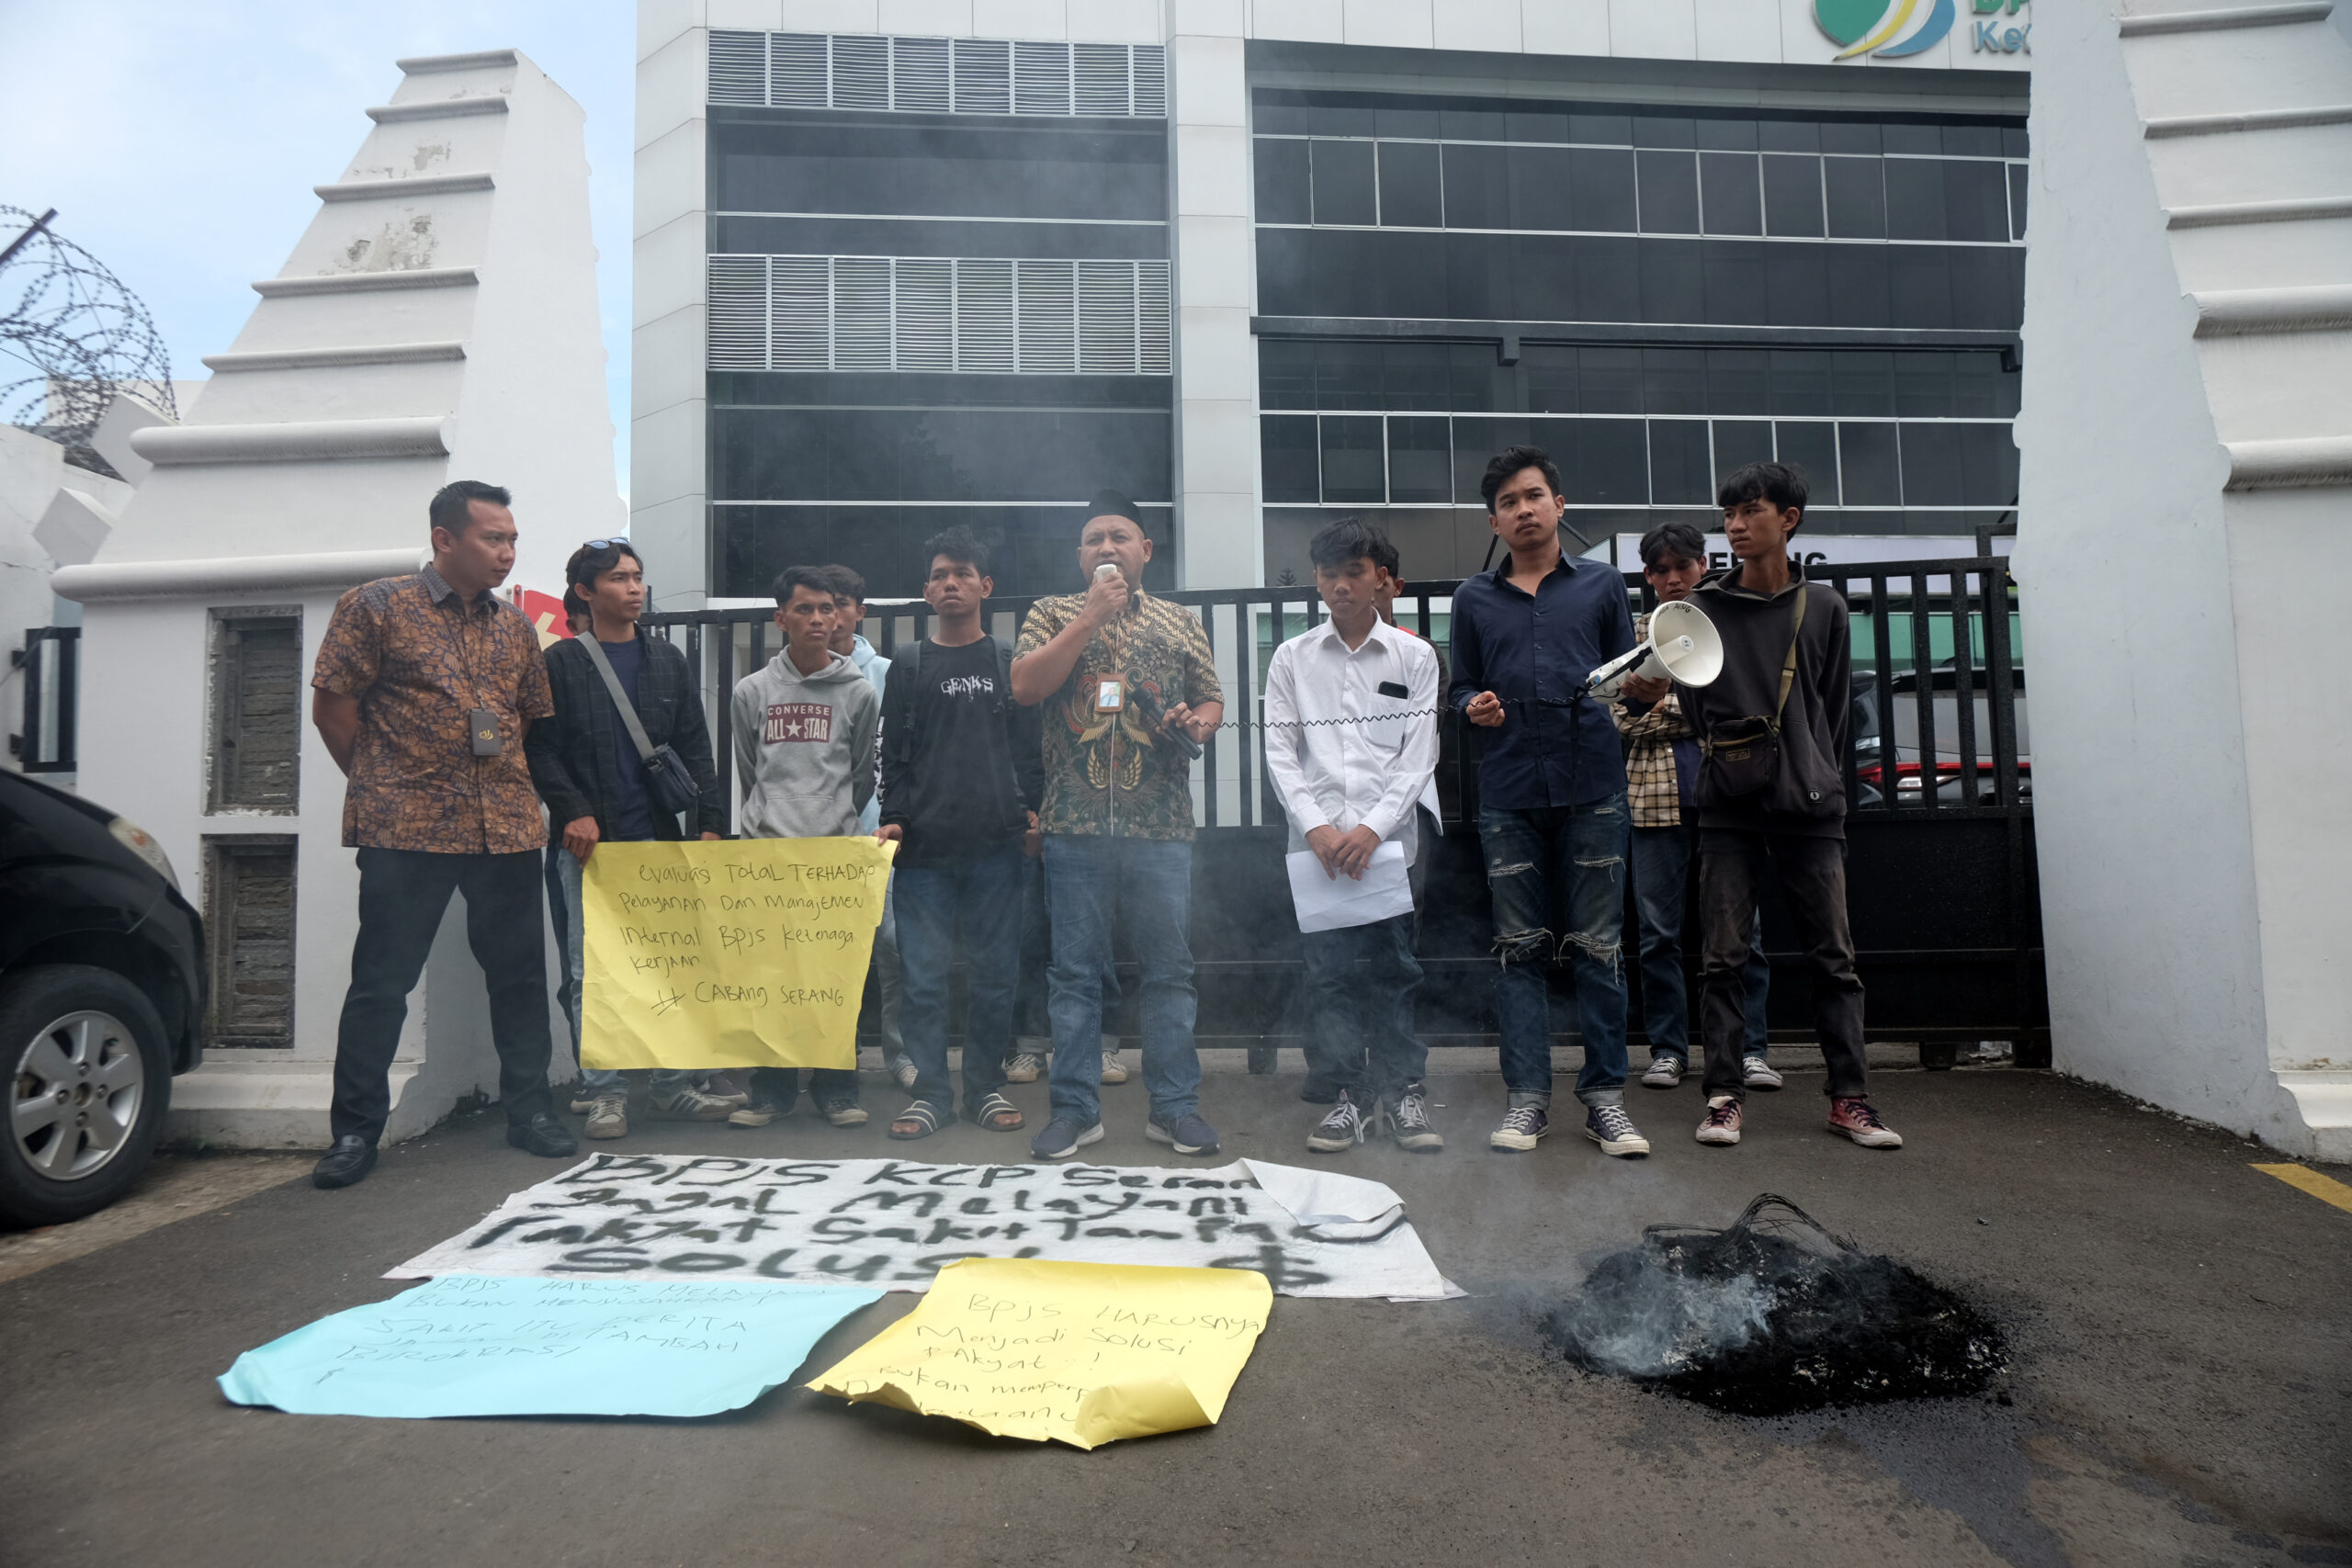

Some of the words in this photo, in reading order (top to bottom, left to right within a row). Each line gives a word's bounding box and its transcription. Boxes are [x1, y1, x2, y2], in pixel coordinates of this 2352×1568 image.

[1973, 20, 2032, 53] Ke
[941, 675, 994, 698] GENKS
[767, 705, 830, 716] CONVERSE
[767, 718, 786, 741] ALL
[804, 717, 828, 740] STAR
[787, 863, 876, 888] TERHADAP
[719, 895, 756, 911] Dan
[780, 985, 844, 1007] SERANG
[554, 1155, 840, 1186] BPJS
[862, 1162, 1036, 1189] KCP
[1059, 1167, 1265, 1190] Seran
[433, 1277, 507, 1293] BPJS
[537, 1280, 641, 1294] HARUS
[364, 1318, 497, 1335] SAKIT
[917, 1325, 1066, 1351] Menjadi
